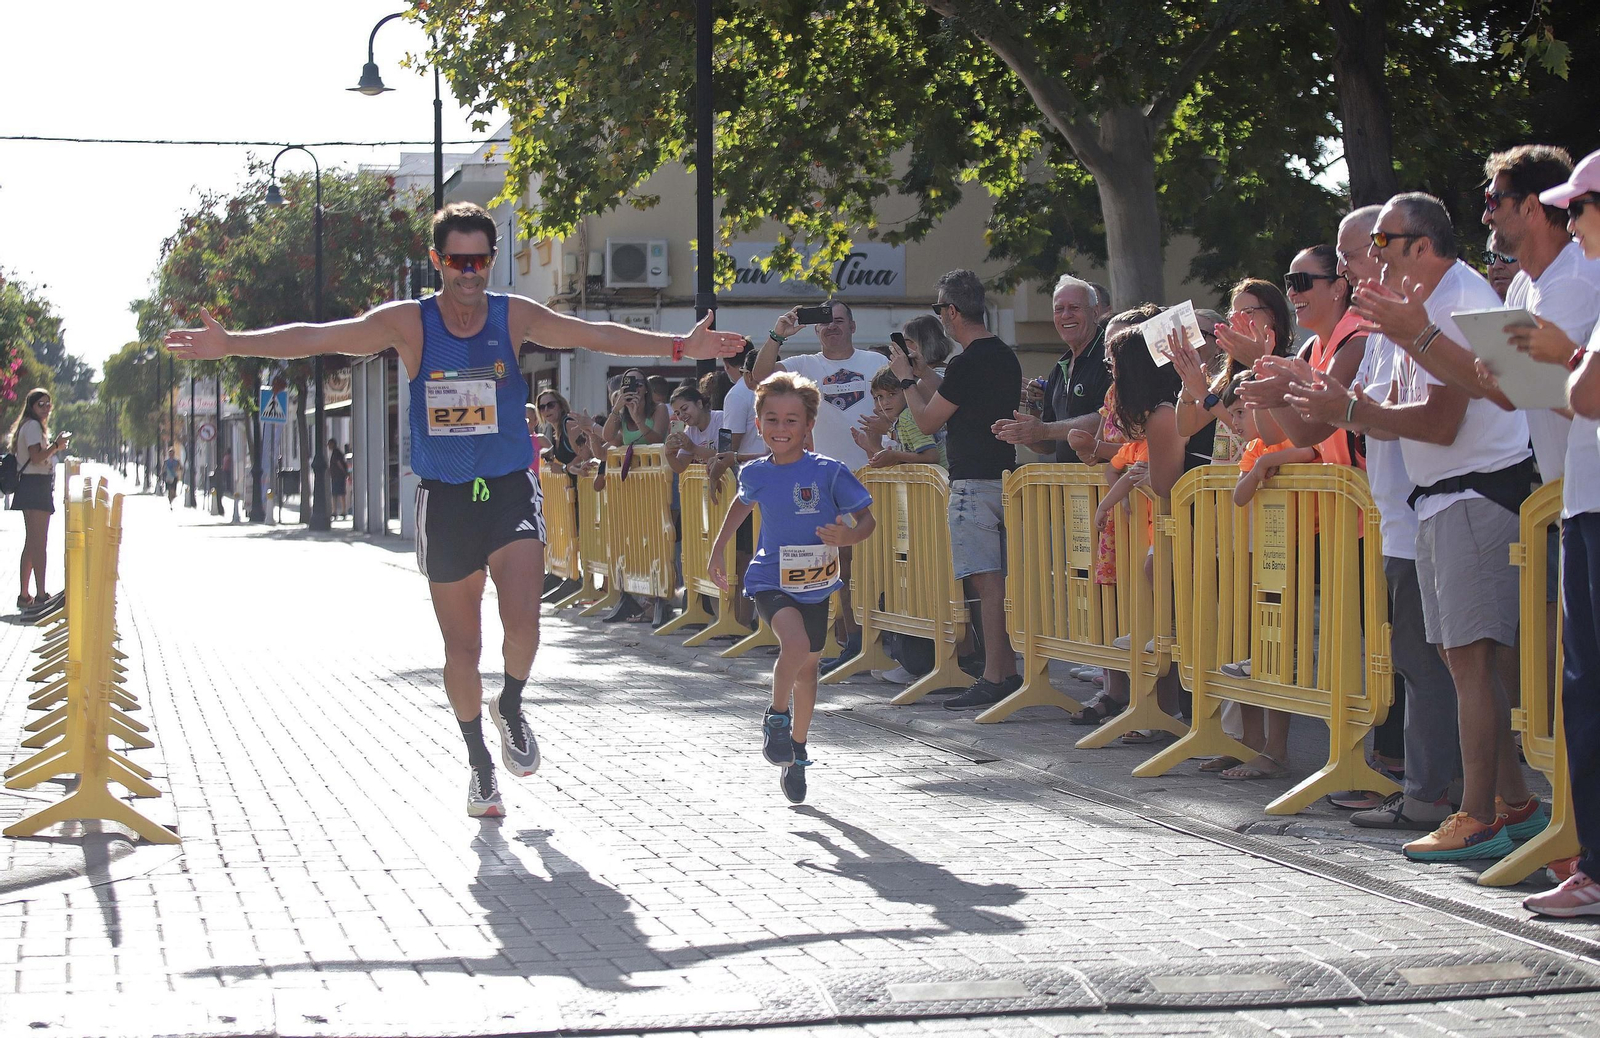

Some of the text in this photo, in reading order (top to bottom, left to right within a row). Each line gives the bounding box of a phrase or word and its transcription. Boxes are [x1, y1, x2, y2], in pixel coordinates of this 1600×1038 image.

[725, 253, 898, 291] an Tina
[434, 407, 486, 423] 271
[788, 560, 836, 581] 270
[1262, 560, 1286, 571] Los Barrios
